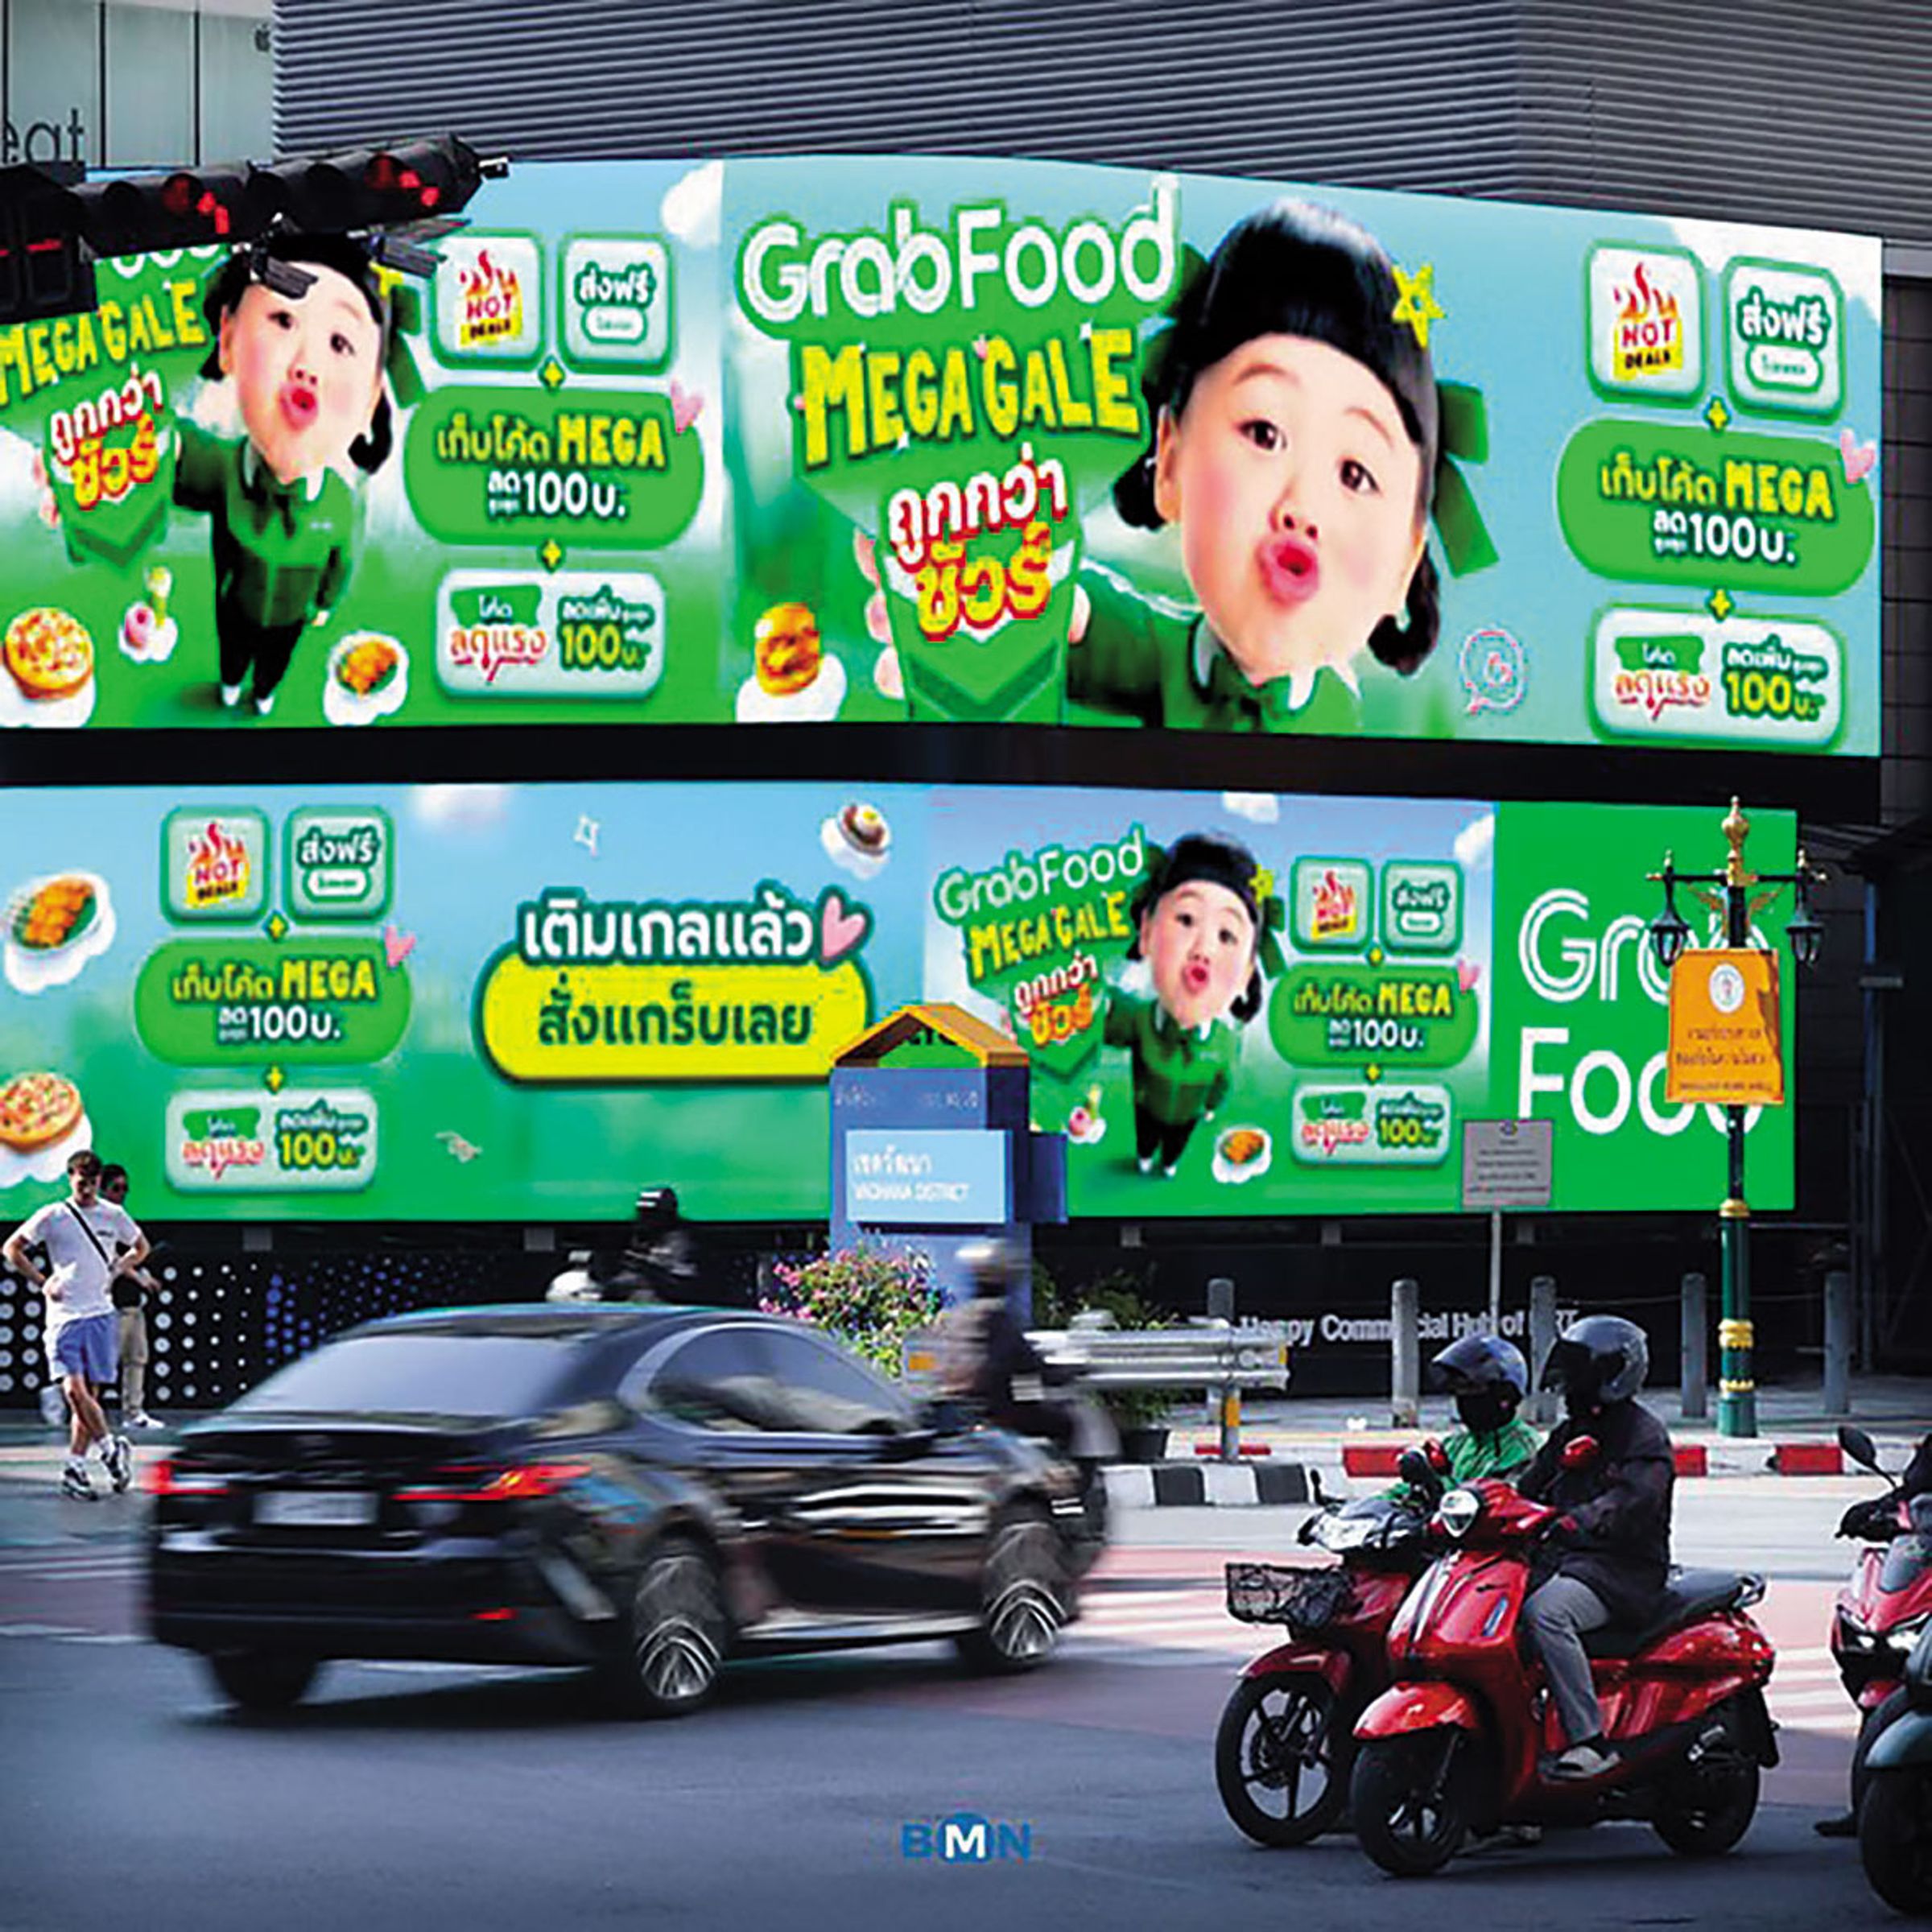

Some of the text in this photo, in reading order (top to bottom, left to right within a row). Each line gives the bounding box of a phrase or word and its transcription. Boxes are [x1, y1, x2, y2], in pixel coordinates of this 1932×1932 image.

[742, 172, 1179, 323] GrabFood
[467, 293, 511, 320] HOT
[1621, 318, 1675, 348] HOT
[1742, 291, 1825, 345] ส่งฟรี
[0, 279, 206, 407] MEGA GALE
[51, 361, 163, 463] ถูกกว่า
[801, 328, 1142, 466] MEGA GALE
[557, 414, 666, 467] MEGA
[888, 442, 1067, 565] ถูกกว่า
[1725, 460, 1834, 520] MEGA
[196, 858, 239, 885] HOT
[939, 828, 1144, 919] GrabFood
[523, 890, 814, 958] เติมเกลแล้ว
[969, 890, 1130, 979] MEGA GALE
[1519, 888, 1770, 1006] Gr
[282, 960, 376, 1000] MEGA
[539, 972, 811, 1046] สั่งแกร็บเลย
[1377, 981, 1452, 1015] MEGA
[1519, 1027, 1764, 1136] Foo
[1501, 1310, 1525, 1337] of
